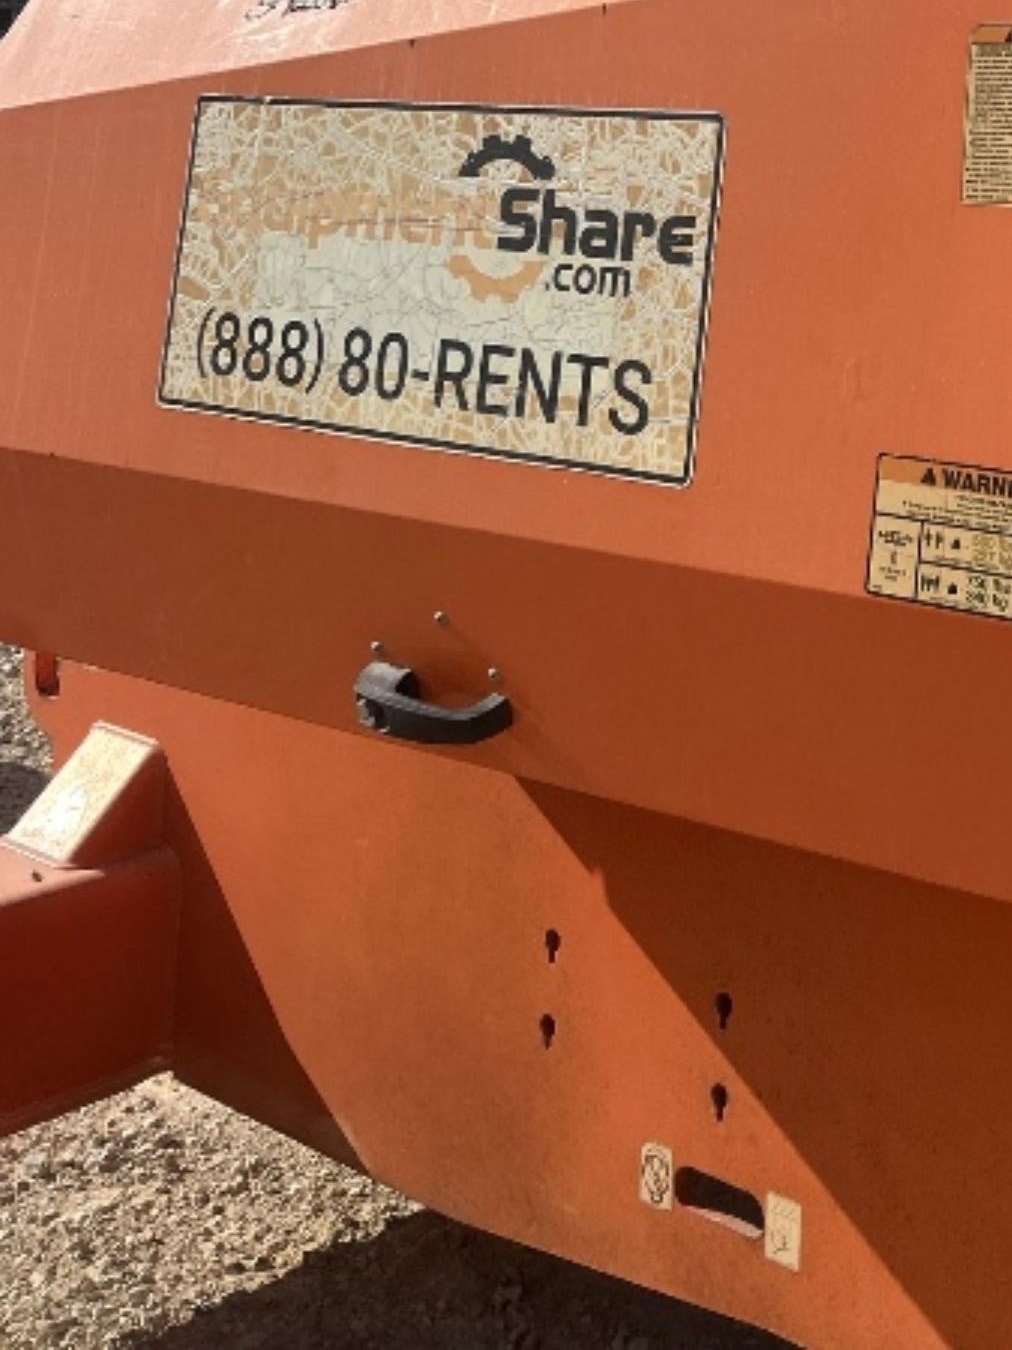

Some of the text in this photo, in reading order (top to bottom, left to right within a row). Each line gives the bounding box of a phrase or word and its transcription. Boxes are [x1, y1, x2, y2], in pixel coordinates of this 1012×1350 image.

[497, 187, 698, 265] Share
[197, 308, 654, 436] (888) 80-RENTS
